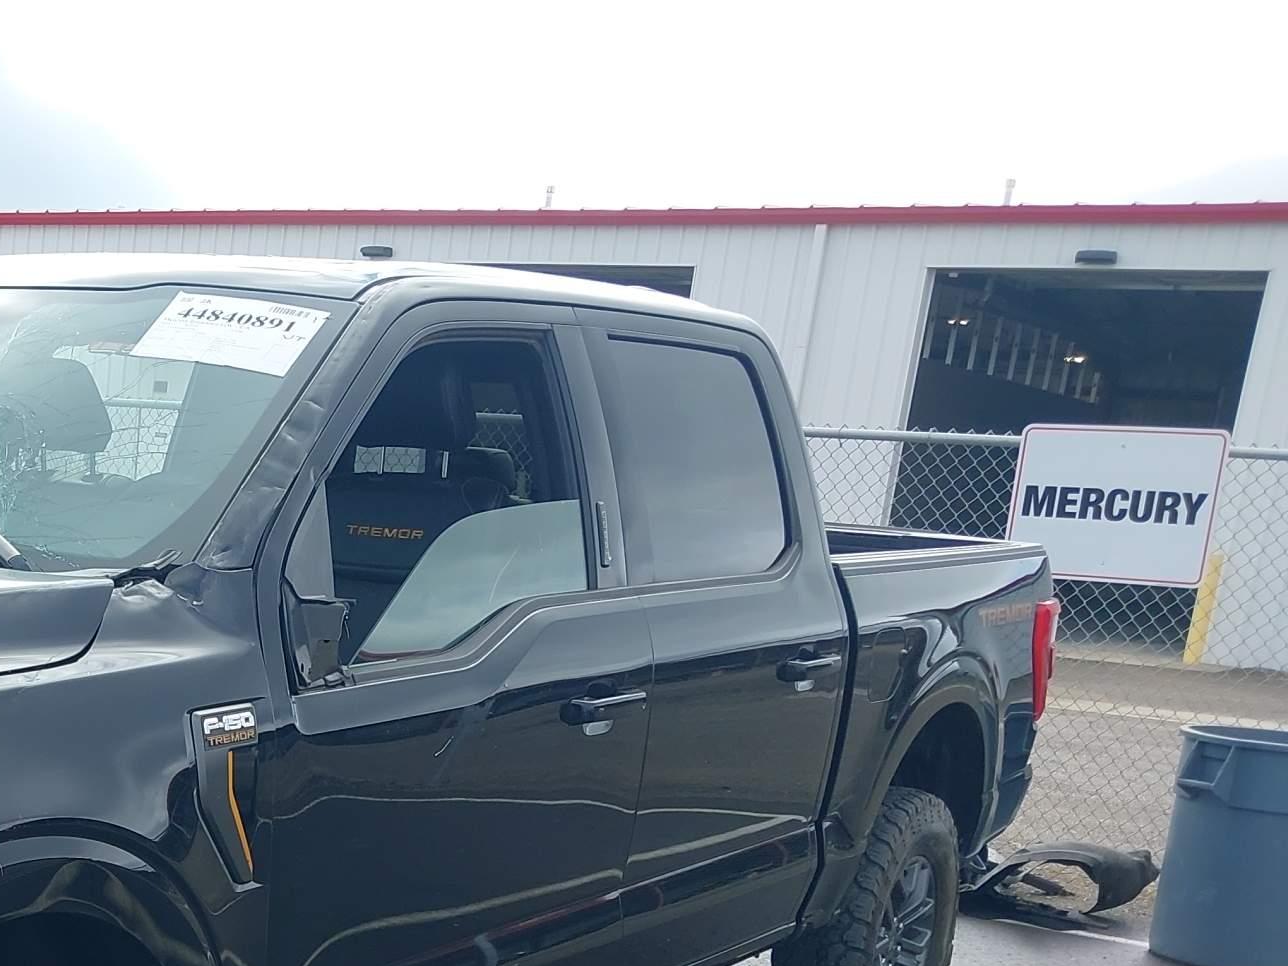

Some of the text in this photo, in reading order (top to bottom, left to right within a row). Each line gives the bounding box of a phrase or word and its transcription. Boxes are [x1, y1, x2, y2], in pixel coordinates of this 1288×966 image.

[177, 306, 297, 332] 44840891
[1021, 484, 1209, 526] MERCURY
[346, 524, 424, 540] TREMOR
[207, 728, 255, 746] TREMOR
